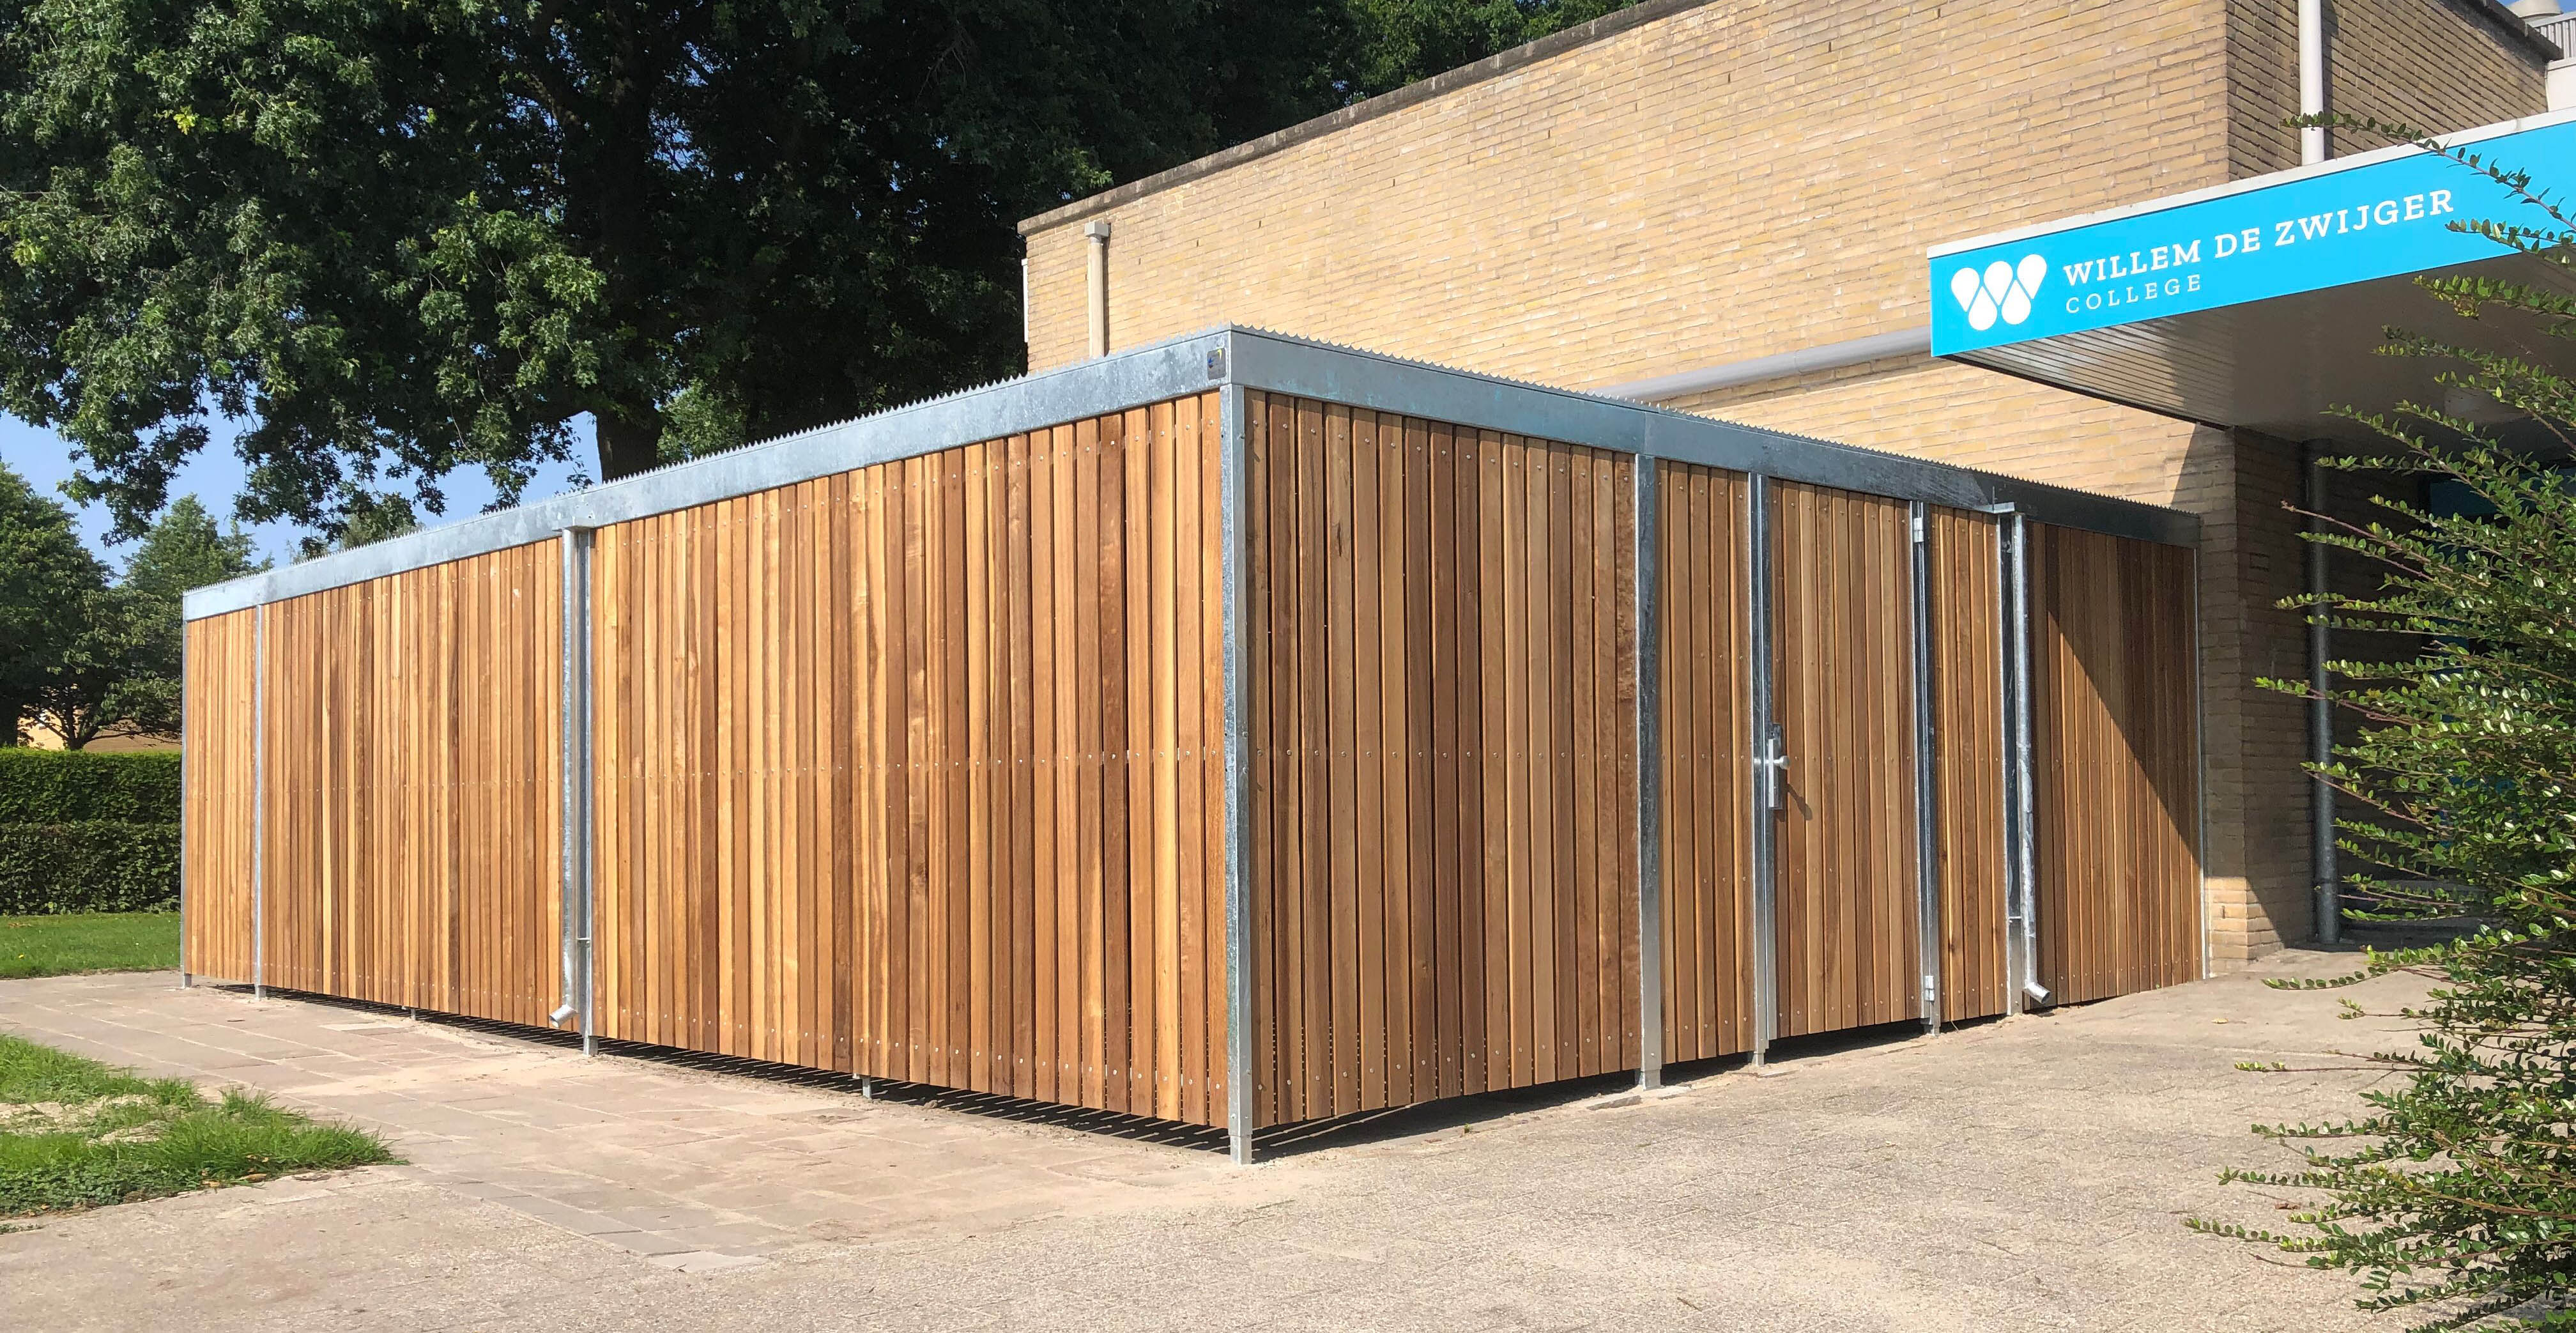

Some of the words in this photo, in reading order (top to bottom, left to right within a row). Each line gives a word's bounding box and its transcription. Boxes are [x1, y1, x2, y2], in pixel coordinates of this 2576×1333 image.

[2063, 239, 2201, 286] WILLEM
[2214, 227, 2260, 258] DE
[2275, 189, 2454, 247] ZWIJGER
[2066, 274, 2201, 313] COLLEGE
